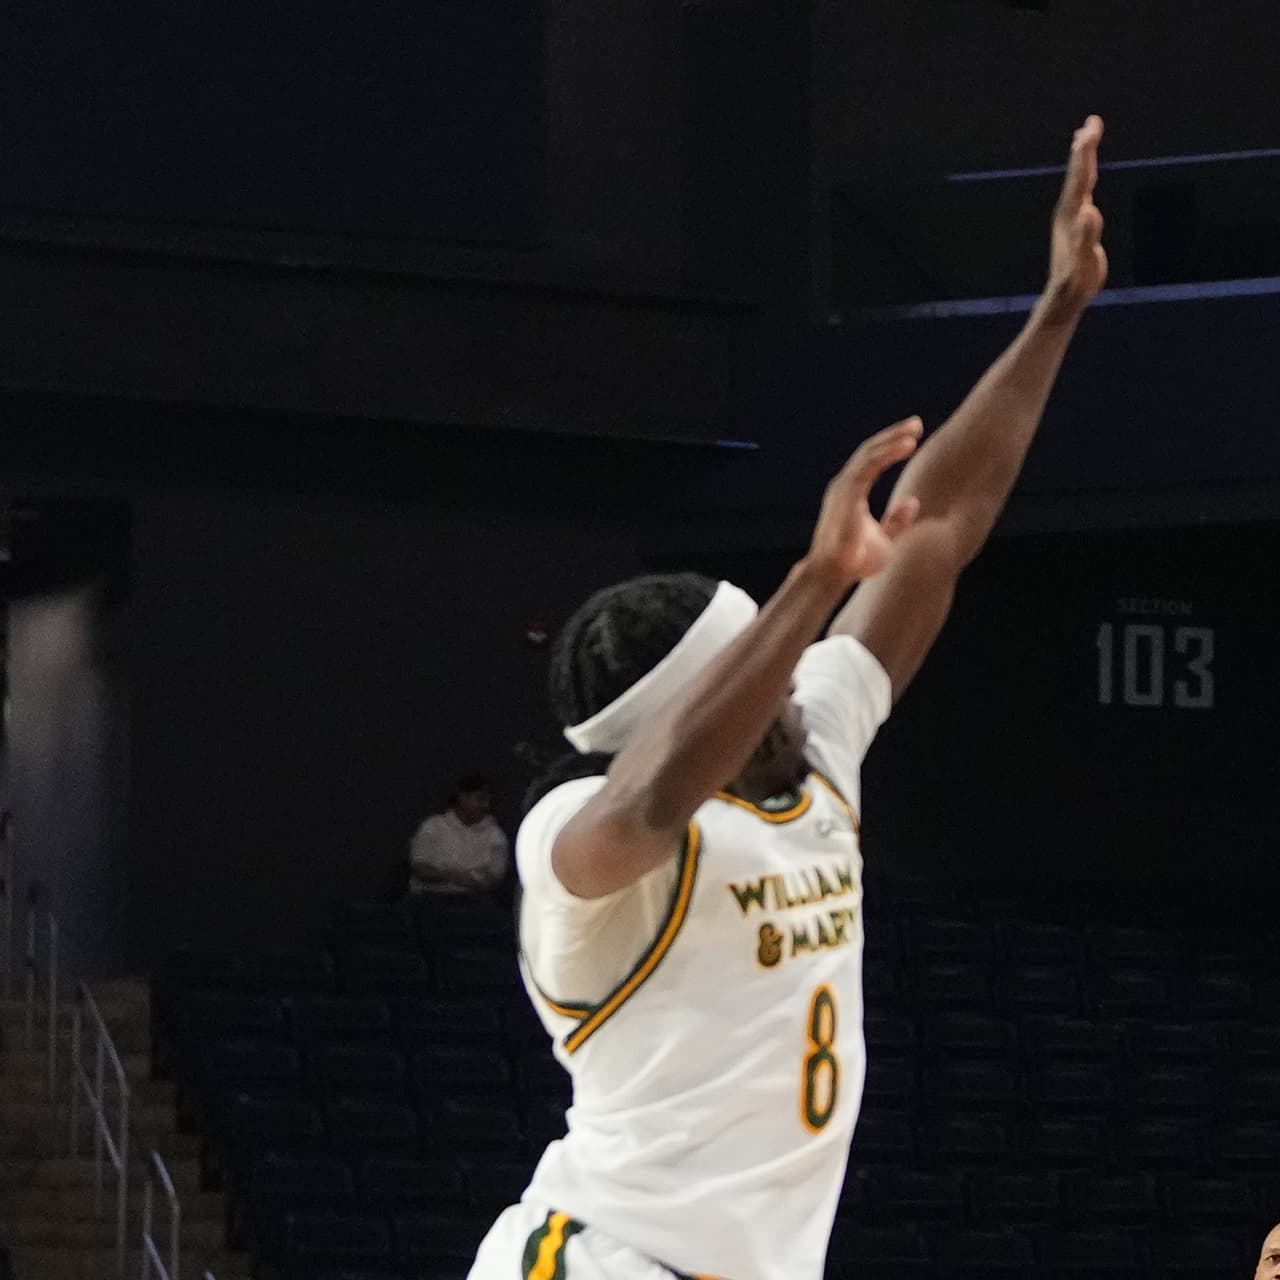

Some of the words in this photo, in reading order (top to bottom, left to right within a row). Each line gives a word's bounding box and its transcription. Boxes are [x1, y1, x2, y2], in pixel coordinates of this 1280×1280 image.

[1096, 622, 1215, 709] 103
[757, 921, 785, 970] &
[800, 982, 841, 1135] 8
